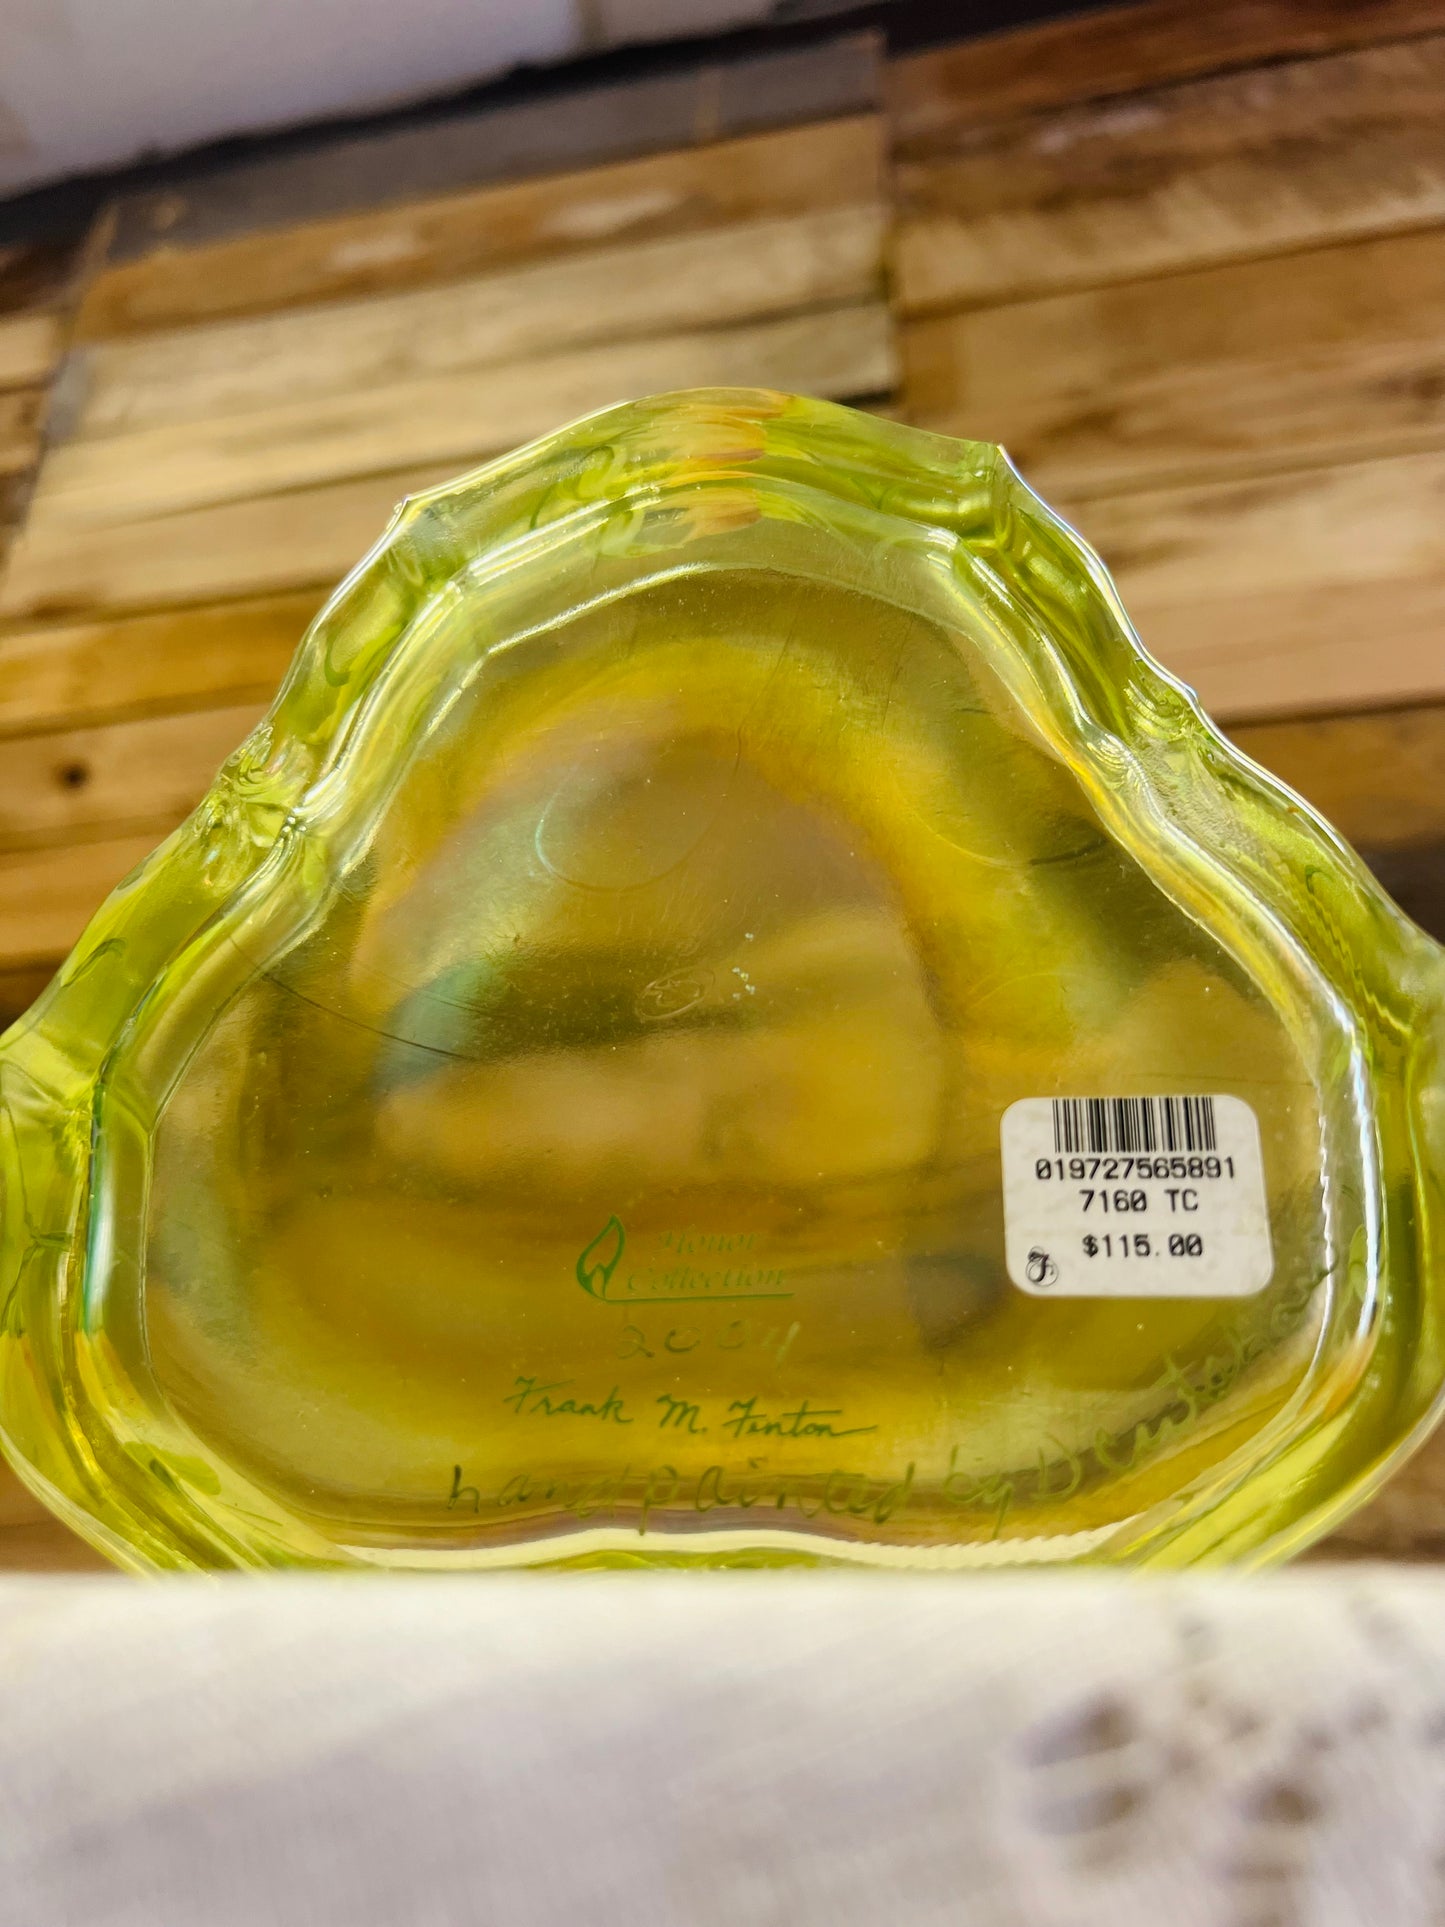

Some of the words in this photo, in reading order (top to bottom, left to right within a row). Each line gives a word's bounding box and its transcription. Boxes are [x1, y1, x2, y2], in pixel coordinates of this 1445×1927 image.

[1035, 1156, 1236, 1181] 019727565891
[1079, 1188, 1148, 1213] 7160
[1164, 1188, 1200, 1212] TC
[1082, 1233, 1205, 1258] $115.00
[503, 1375, 635, 1425] Frank
[723, 1396, 879, 1438] Fenton
